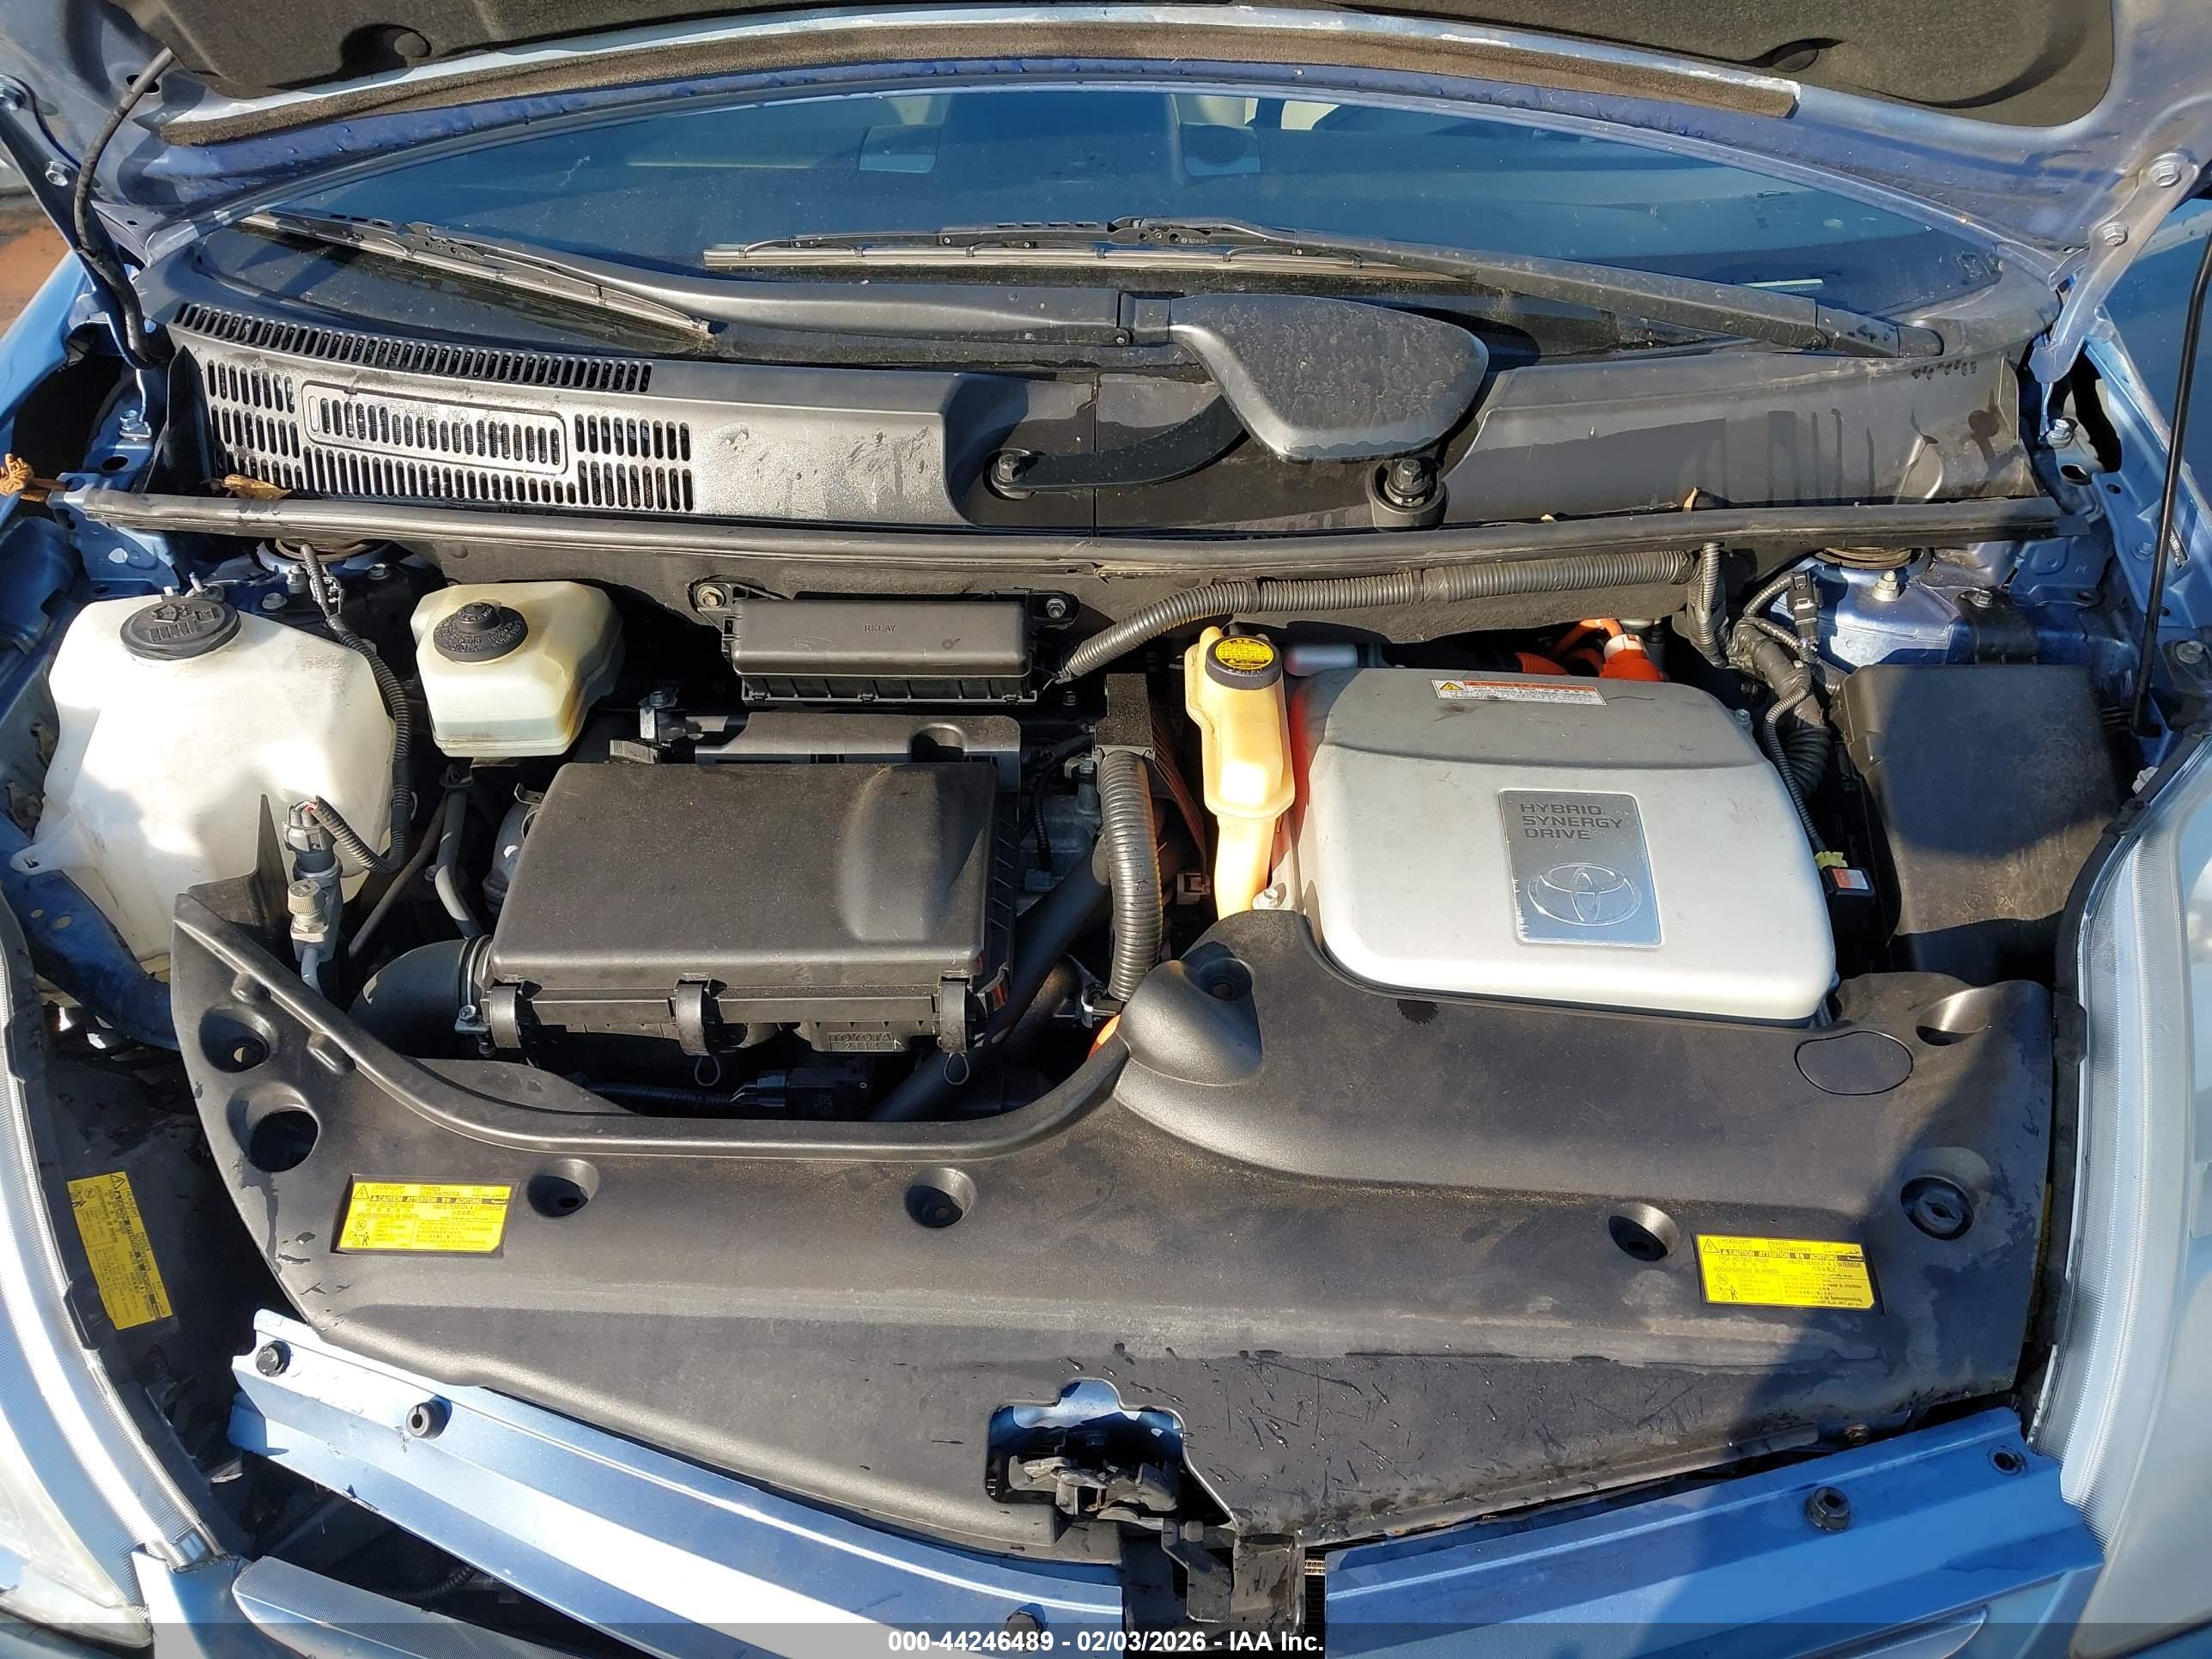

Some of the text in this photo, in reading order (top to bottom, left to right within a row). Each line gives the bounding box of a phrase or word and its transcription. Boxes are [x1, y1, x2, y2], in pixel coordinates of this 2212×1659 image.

[863, 624, 896, 633] RELAY
[1520, 803, 1602, 816] HYBRID
[1522, 816, 1623, 830] SYNERGY
[1524, 828, 1591, 840] DRIVE
[832, 1032, 892, 1042] TOYOTA
